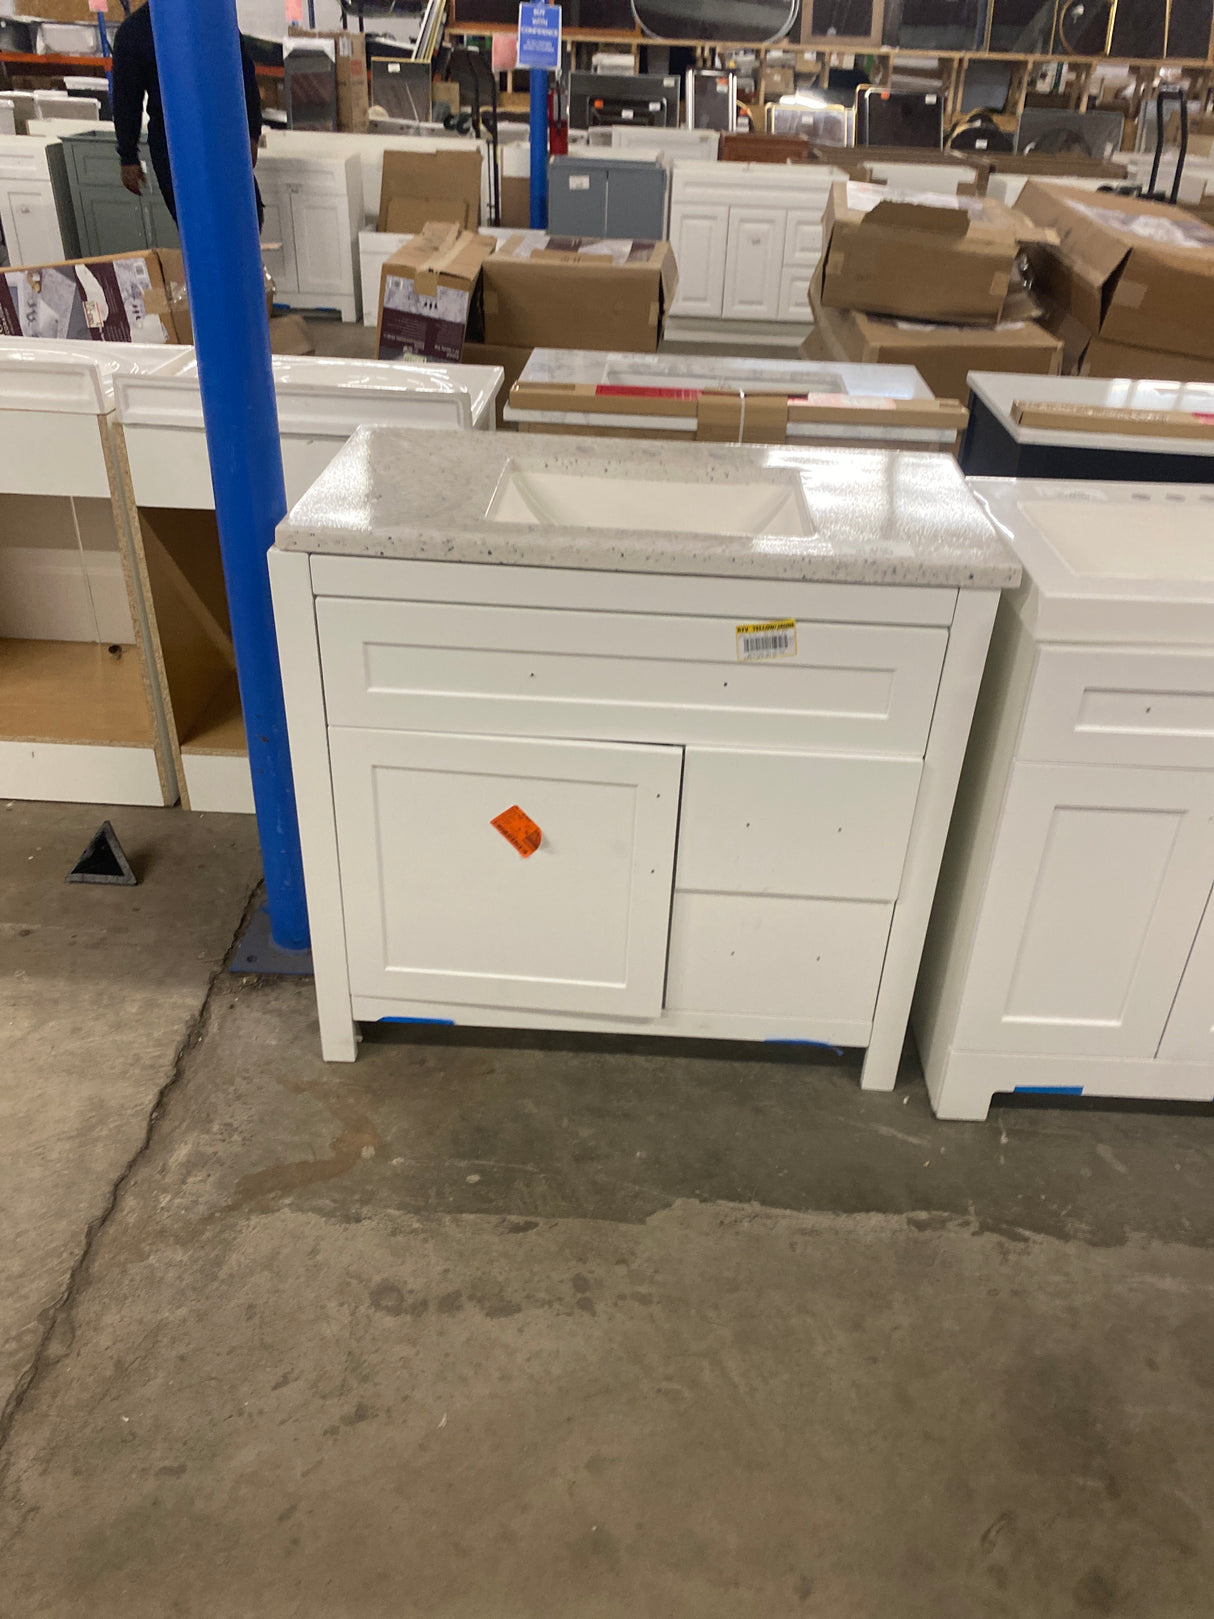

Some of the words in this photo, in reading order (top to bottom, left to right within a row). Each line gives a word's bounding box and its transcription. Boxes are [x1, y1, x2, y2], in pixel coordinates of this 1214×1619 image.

[533, 8, 546, 16] BUY
[532, 17, 548, 26] WITH
[521, 26, 558, 37] CONFIDENCE
